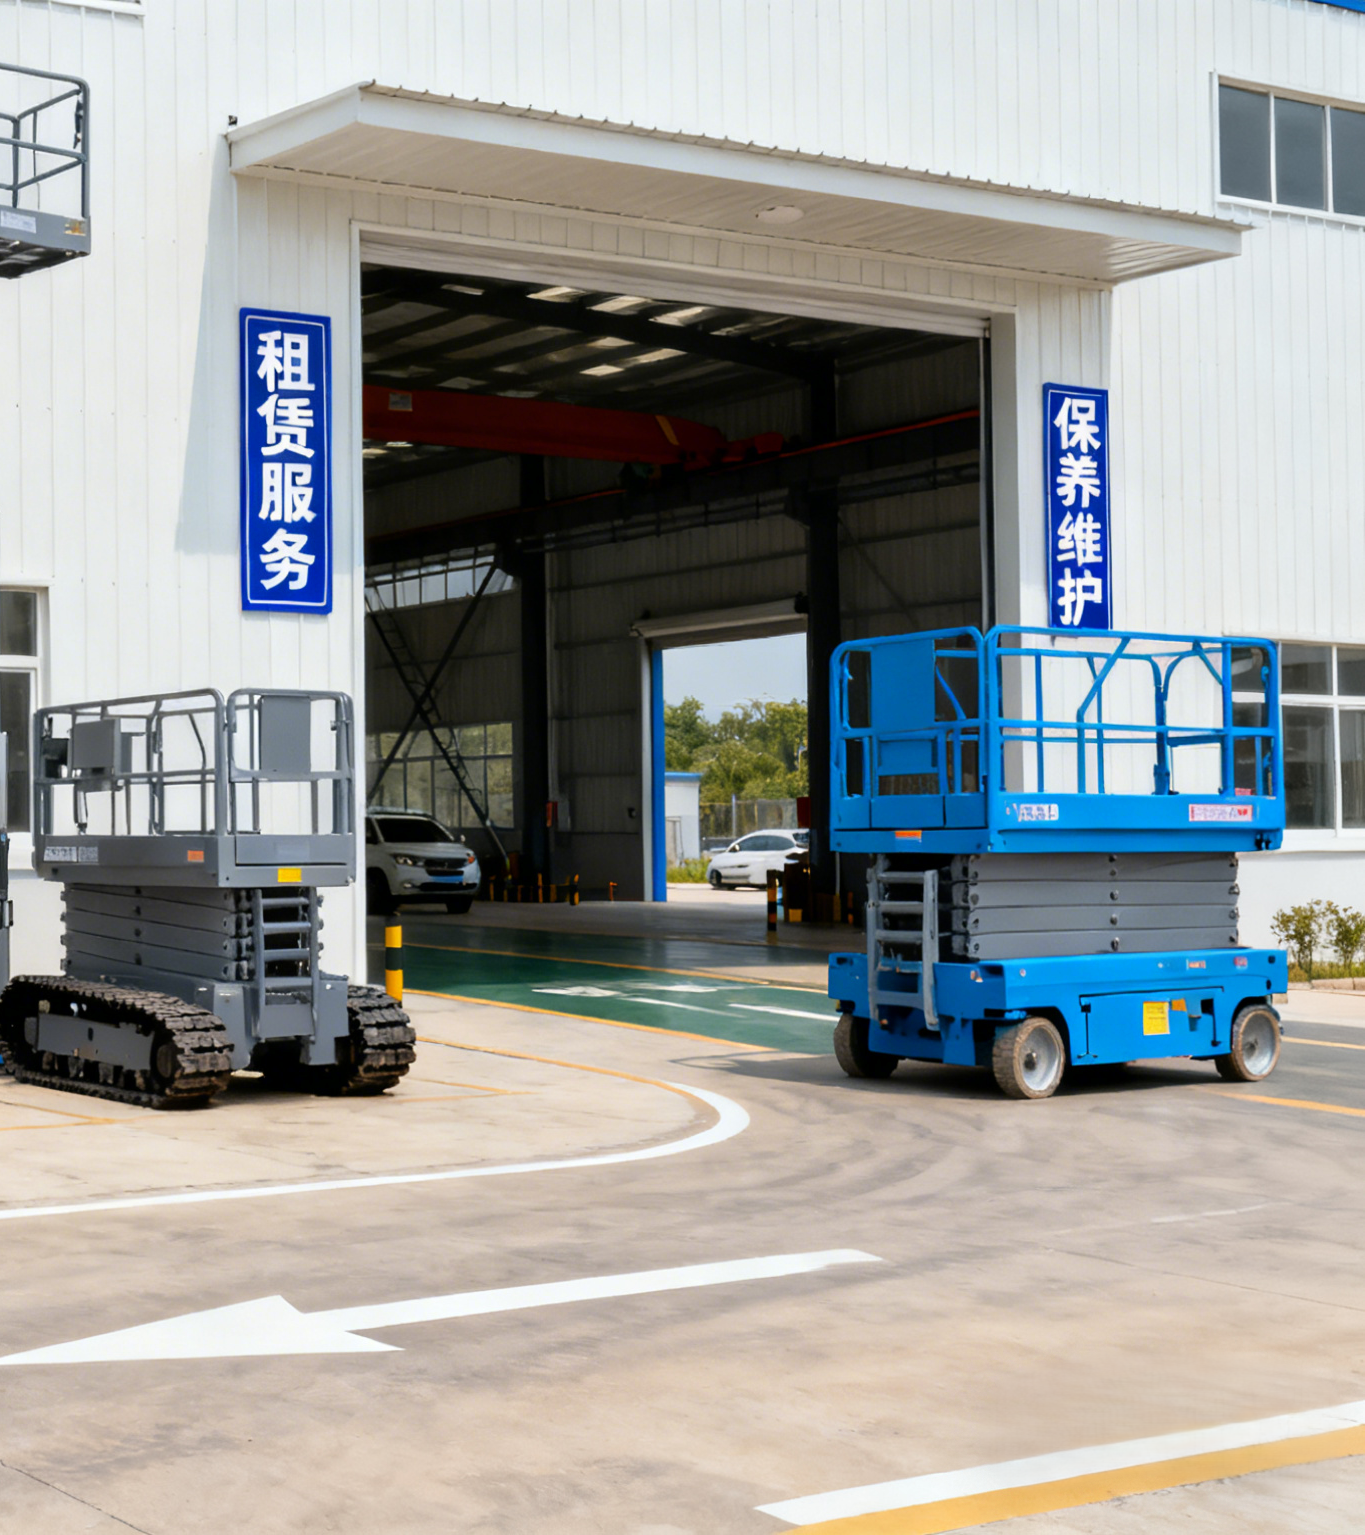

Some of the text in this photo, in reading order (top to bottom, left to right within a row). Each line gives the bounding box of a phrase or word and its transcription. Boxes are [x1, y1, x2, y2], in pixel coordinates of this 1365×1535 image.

[256, 329, 317, 591] 租赁服务
[1053, 397, 1103, 626] 保养维护
